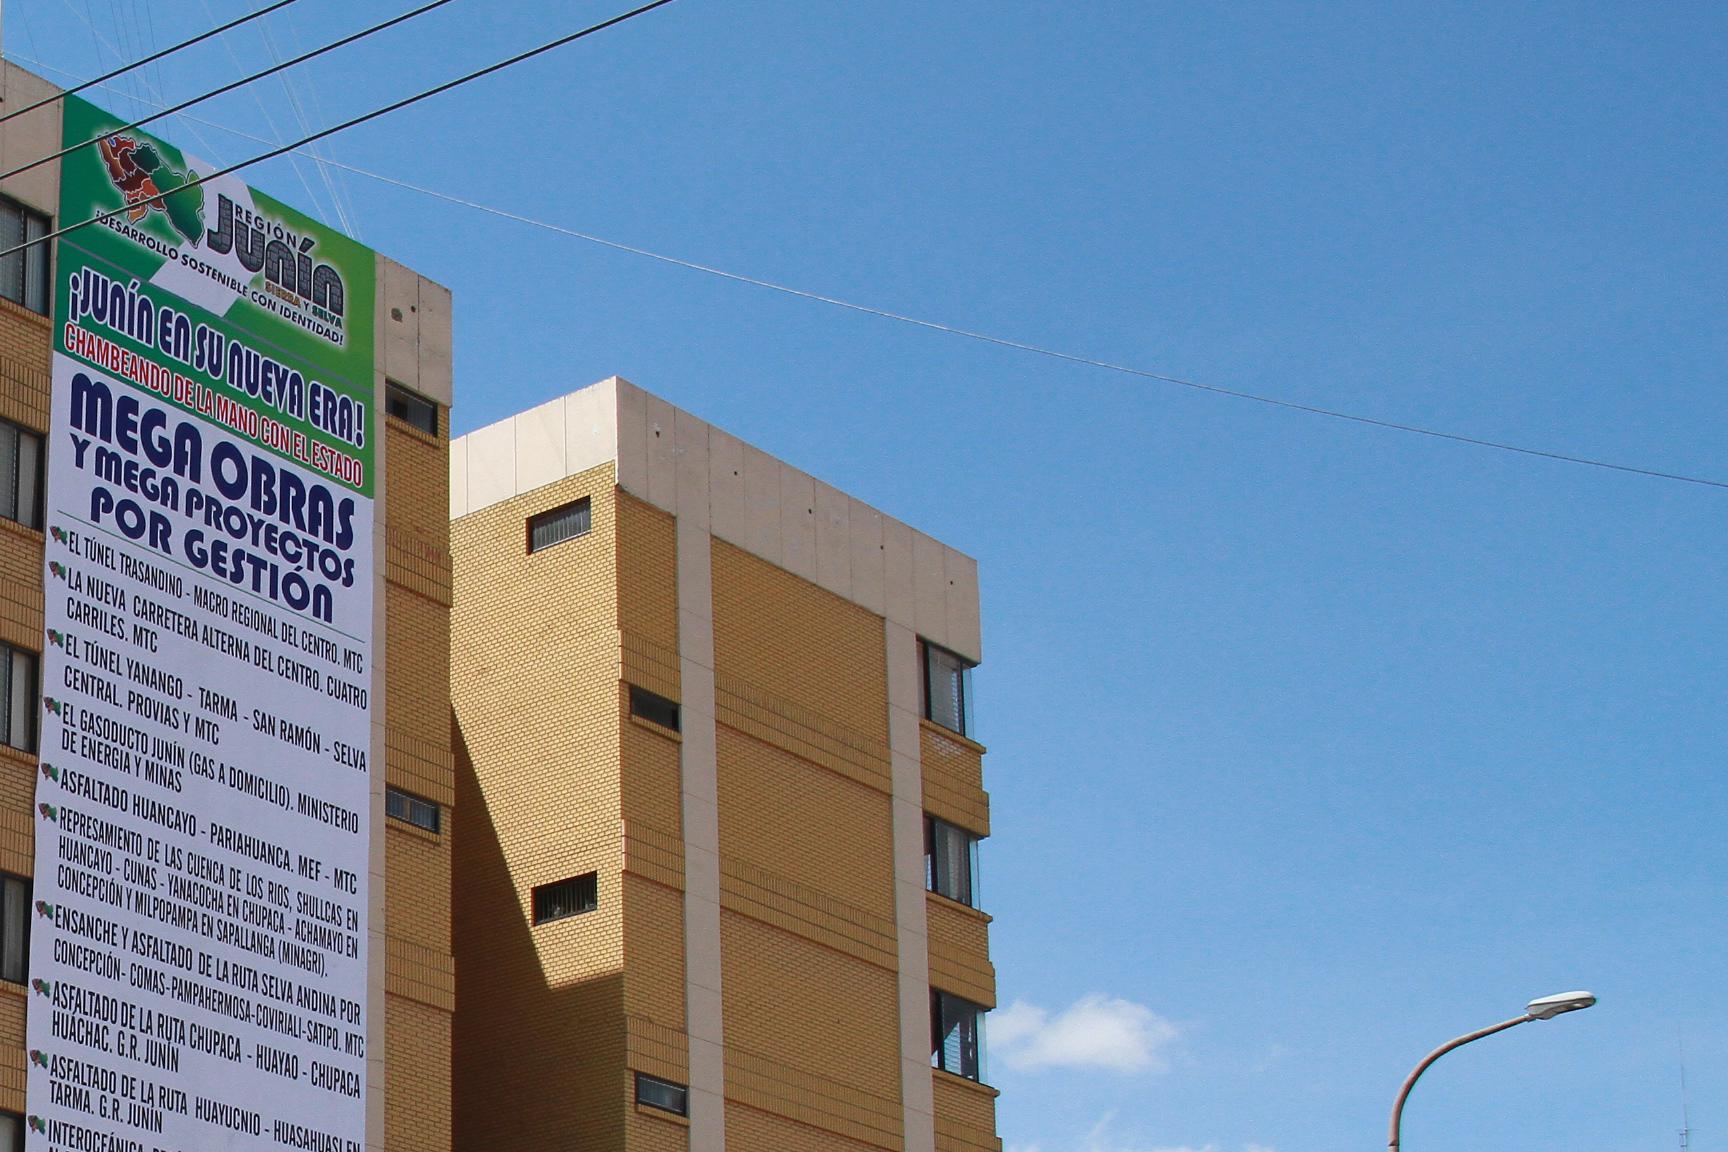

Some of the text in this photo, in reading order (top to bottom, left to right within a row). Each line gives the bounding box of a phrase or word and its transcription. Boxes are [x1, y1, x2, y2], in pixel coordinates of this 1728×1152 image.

[236, 200, 296, 248] REGIÓN
[181, 252, 247, 297] SOSTENIBLE
[251, 288, 275, 312] CON
[279, 302, 343, 346] IDENTIDAD!
[303, 299, 308, 312] Y
[65, 321, 362, 488] CHAMBEANDO DE LA MANO CON EL ESTADO
[158, 304, 190, 366] EN
[194, 321, 223, 382] SU
[227, 338, 304, 421] NUEVA
[308, 377, 363, 450] ERA!
[68, 433, 354, 590] Y MEGA PROYECTOS
[69, 369, 354, 554] MEGA OBRAS
[83, 537, 339, 665] TÚNEL TRASANDINO MACRO REGIONAL CENTRO.
[90, 483, 333, 624] POR GESTIÓN
[66, 596, 128, 642] CARRILES.
[89, 576, 366, 711] NUEVA CARRETERA ALTERNA CENTRO. CUATRO
[64, 665, 179, 730] CENTRAL. PROVIAS
[83, 641, 365, 772] TÚNEL YANANGO TARMA RAMÓN SELVA
[60, 768, 293, 873] ASFALTADO HUANCAYO PARIAHUANCA.
[80, 709, 358, 834] GASODUCTO JUNÍN (GAS DOMICILIO). MINISTERIO
[81, 735, 181, 793] ENERGIA MINAS
[57, 864, 327, 979] CONCEPCIÓN MILPOPAMPA SAPALLANGA (MINAGRI).
[58, 835, 342, 954] HUANCAYO CUNAS YANACOCHA CHUPACA ACHAMAYO
[59, 807, 342, 927] REPRESAMIENTO CUENCA RIOS, SHULLCAS
[55, 904, 336, 1018] ENSANCHE ASFALTADO RUTA SELVA ANDINA
[50, 1053, 116, 1095] ASFALTADO
[159, 1085, 187, 1115] RUTA
[52, 980, 360, 1098] ASFALTADO RUTA CHUPACA HUAYAO CHUPACA
[117, 1030, 140, 1061] G.R.
[145, 1038, 179, 1072] JUNÍN
[50, 1080, 94, 1115] TARMA.
[99, 1094, 123, 1123] G.R.
